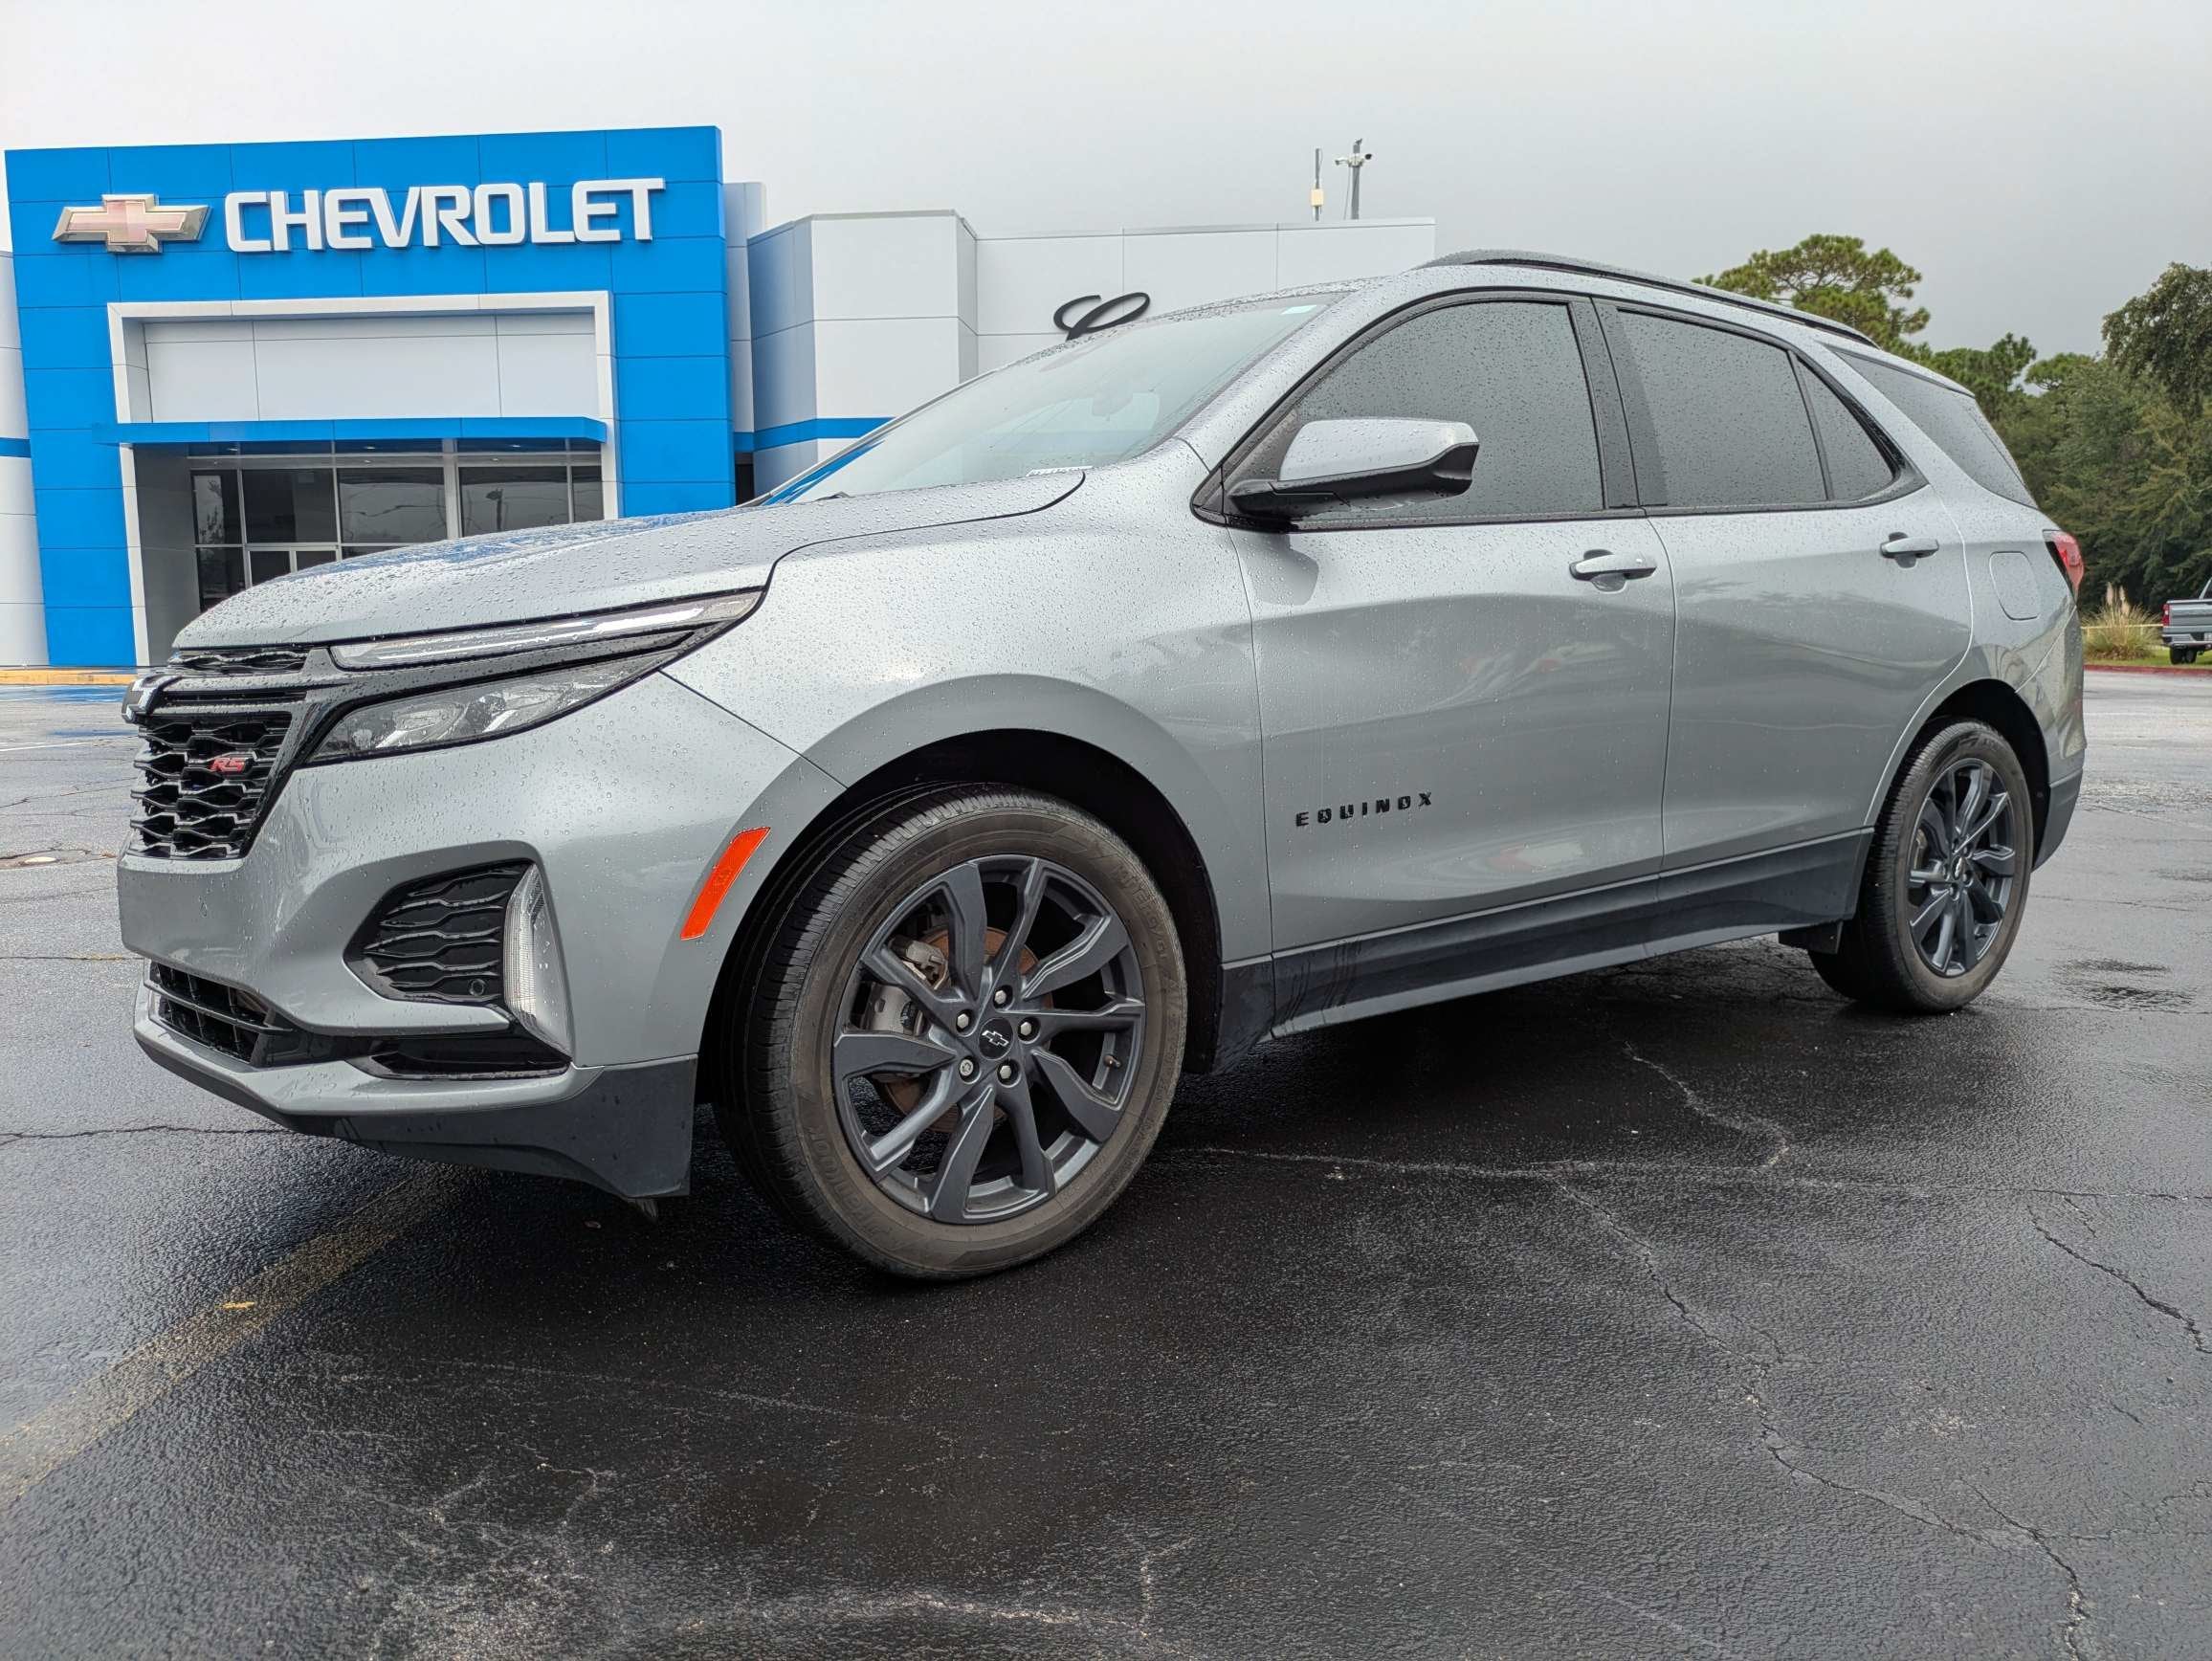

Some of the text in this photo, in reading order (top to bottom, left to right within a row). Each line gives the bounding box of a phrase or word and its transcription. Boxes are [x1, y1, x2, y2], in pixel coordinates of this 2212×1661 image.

[225, 178, 666, 253] CHEVROLET
[210, 757, 246, 772] RS
[1295, 791, 1432, 827] EQUINOX
